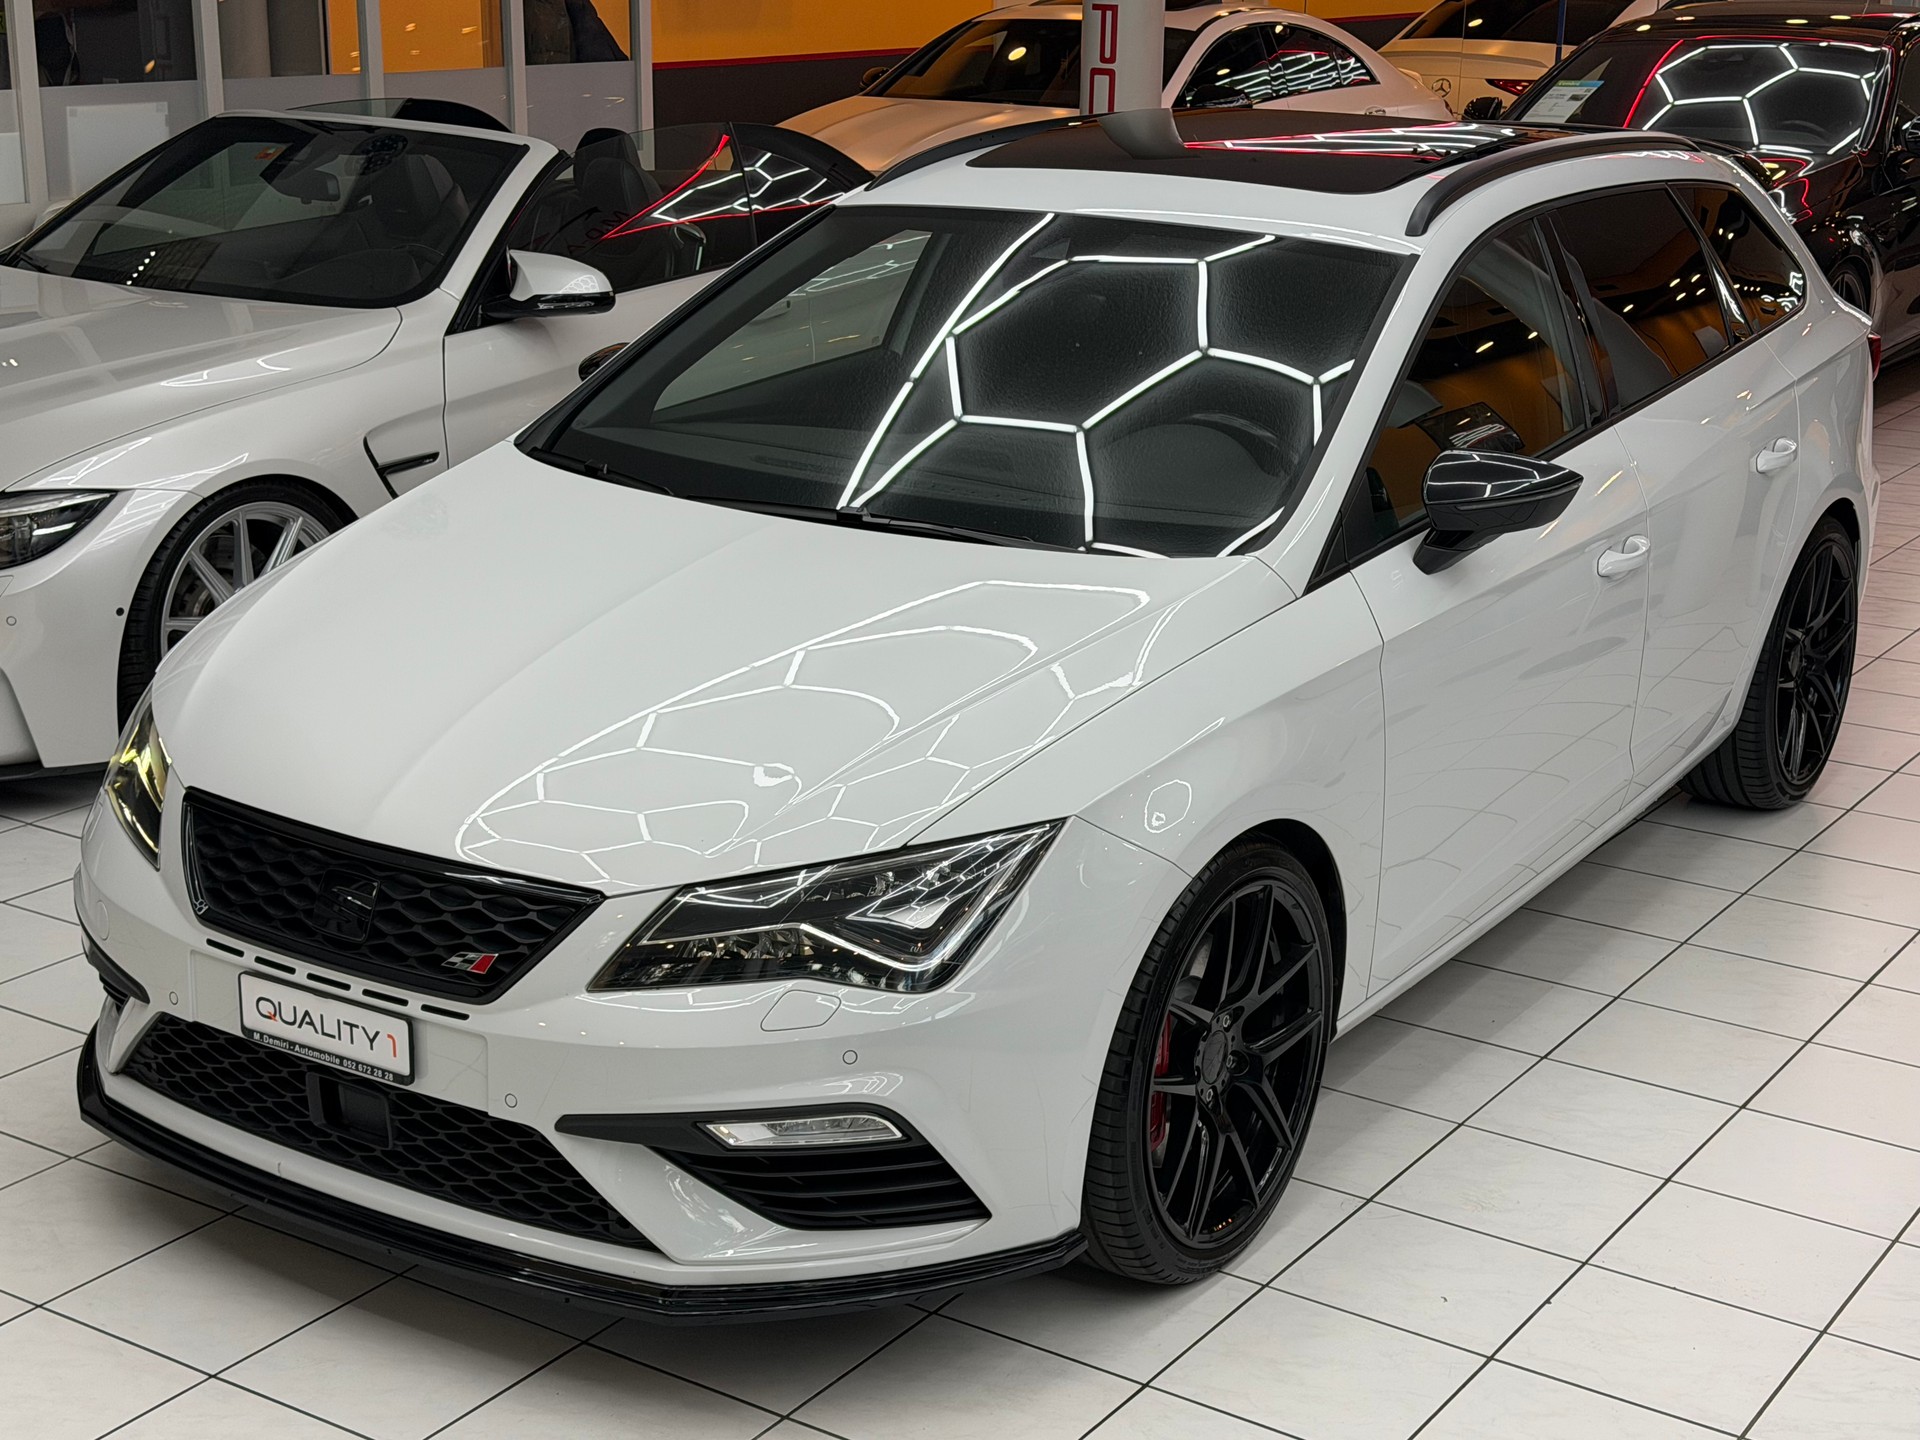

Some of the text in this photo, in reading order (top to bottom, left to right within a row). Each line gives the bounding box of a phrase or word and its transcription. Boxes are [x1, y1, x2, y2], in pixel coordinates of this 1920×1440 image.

[256, 996, 397, 1058] QUALITY 1
[295, 1044, 340, 1064] Automobile
